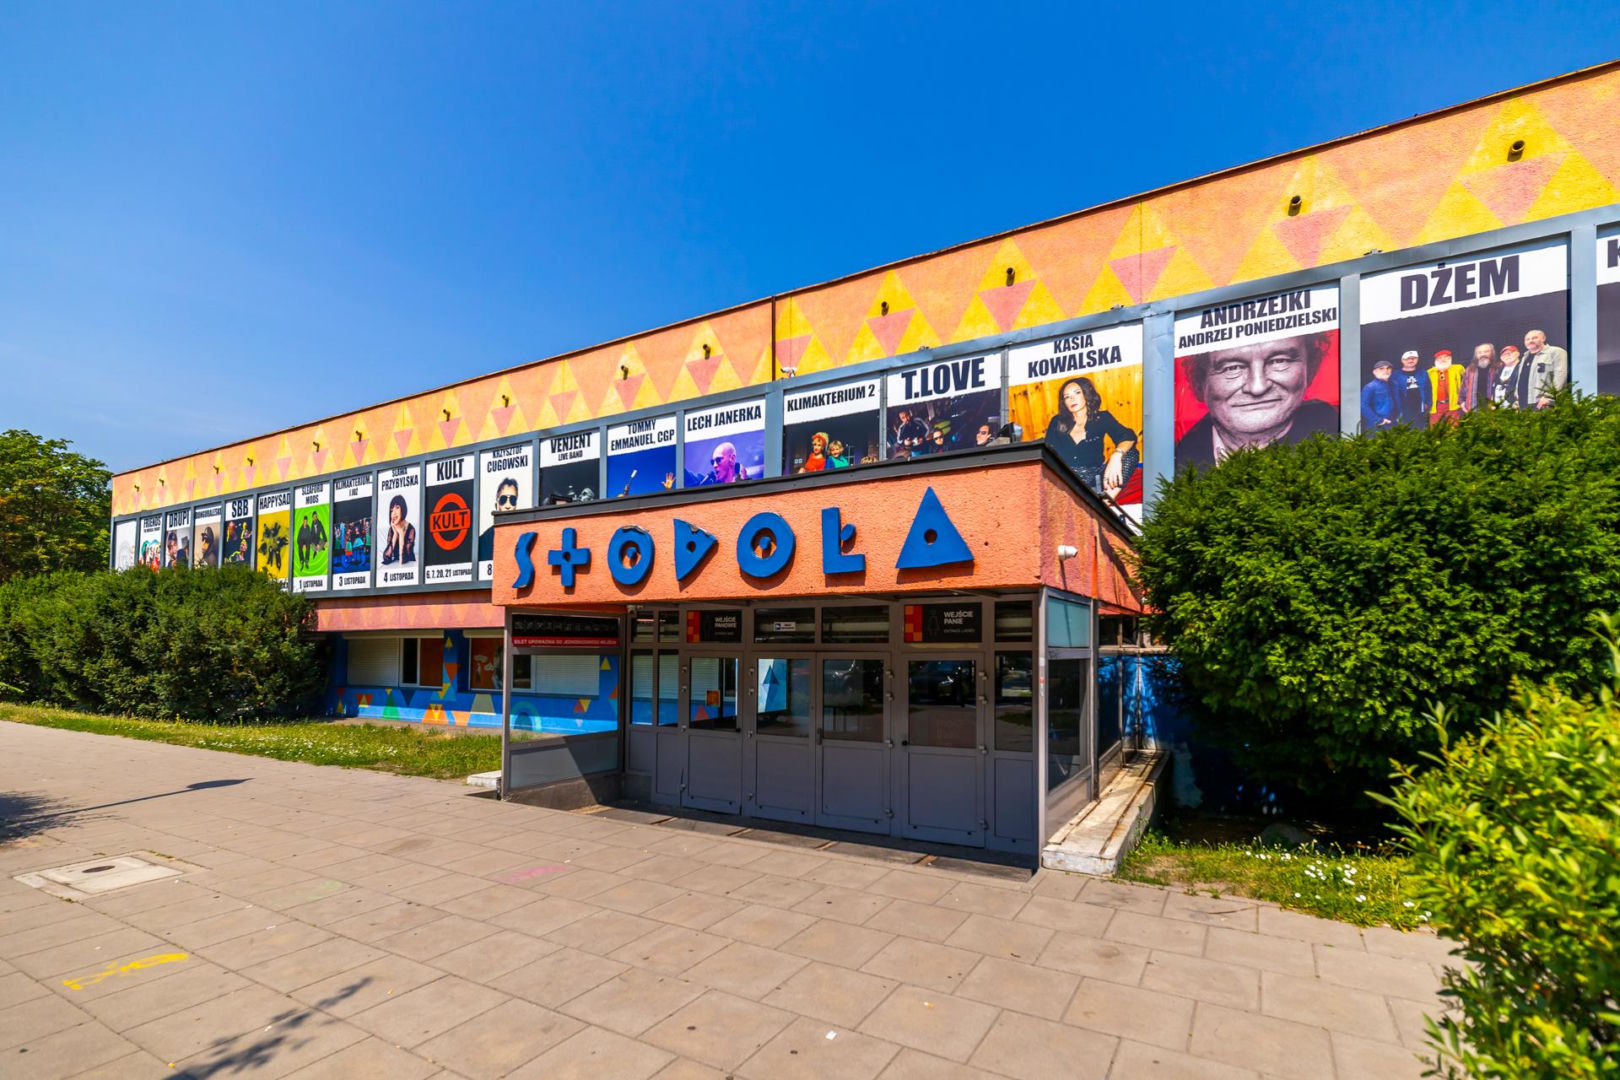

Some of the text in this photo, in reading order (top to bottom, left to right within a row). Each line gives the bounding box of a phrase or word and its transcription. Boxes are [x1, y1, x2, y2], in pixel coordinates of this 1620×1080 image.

[1400, 255, 1520, 312] DŻEM
[1200, 289, 1311, 329] ANDRZEJKI
[1178, 307, 1337, 349] ANDRZEJ PONIEDZIELSKI
[1053, 334, 1094, 354] KASIA
[1027, 345, 1122, 378] KOWALSKA
[901, 357, 986, 400] T.LOVE
[787, 384, 875, 412] KLIMAKTERIUM 2
[627, 419, 657, 435] TOMMY
[687, 405, 762, 432] LECH JANERKA
[550, 432, 592, 454] VENJENT
[610, 429, 675, 451] EMMANUEL, CGP
[492, 444, 523, 458] KRZYSZTOF
[558, 450, 583, 461] LIVE BAND
[436, 458, 465, 482] KULT
[487, 455, 528, 473] CUGOWSKI
[302, 484, 323, 496] SLEAFORD
[381, 474, 419, 491] PRZYBYLSKA
[231, 499, 249, 518] SBB
[259, 493, 290, 510] HAPPYSAD
[305, 494, 319, 504] MODS
[169, 509, 190, 528] DRUPI
[432, 511, 468, 530] KULT
[384, 572, 414, 583] 4 LISTOPADA
[487, 564, 492, 575] 8
[339, 576, 343, 587] 3
[943, 610, 974, 618] WEJŚCIE
